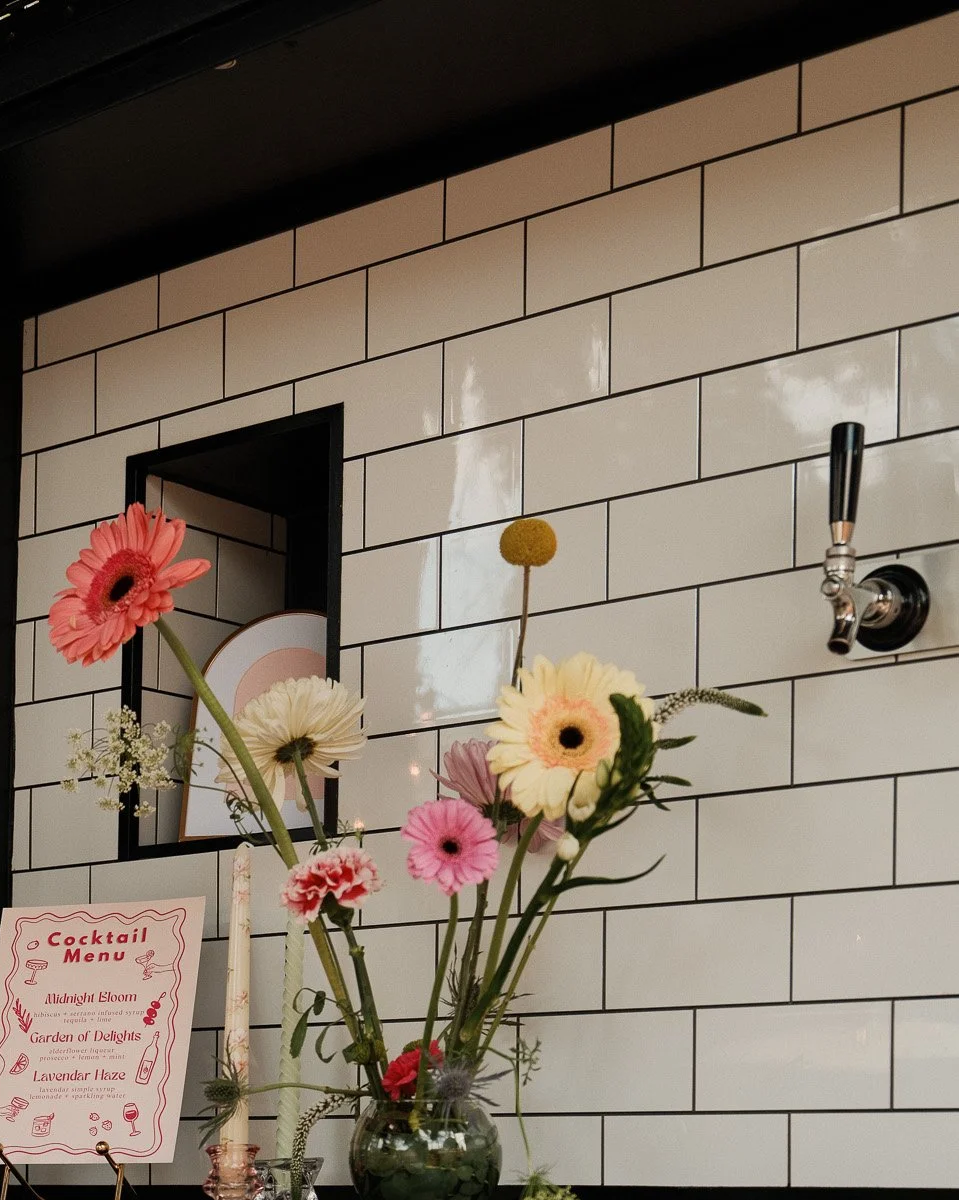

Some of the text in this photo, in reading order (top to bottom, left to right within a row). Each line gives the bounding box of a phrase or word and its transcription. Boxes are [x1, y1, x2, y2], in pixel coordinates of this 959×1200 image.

[48, 927, 148, 947] Cocktail
[63, 949, 125, 963] Menu
[44, 991, 137, 1006] Midnight Bloom
[30, 1030, 141, 1044] Garden of Delights
[33, 1069, 126, 1082] Lavendar Haze
